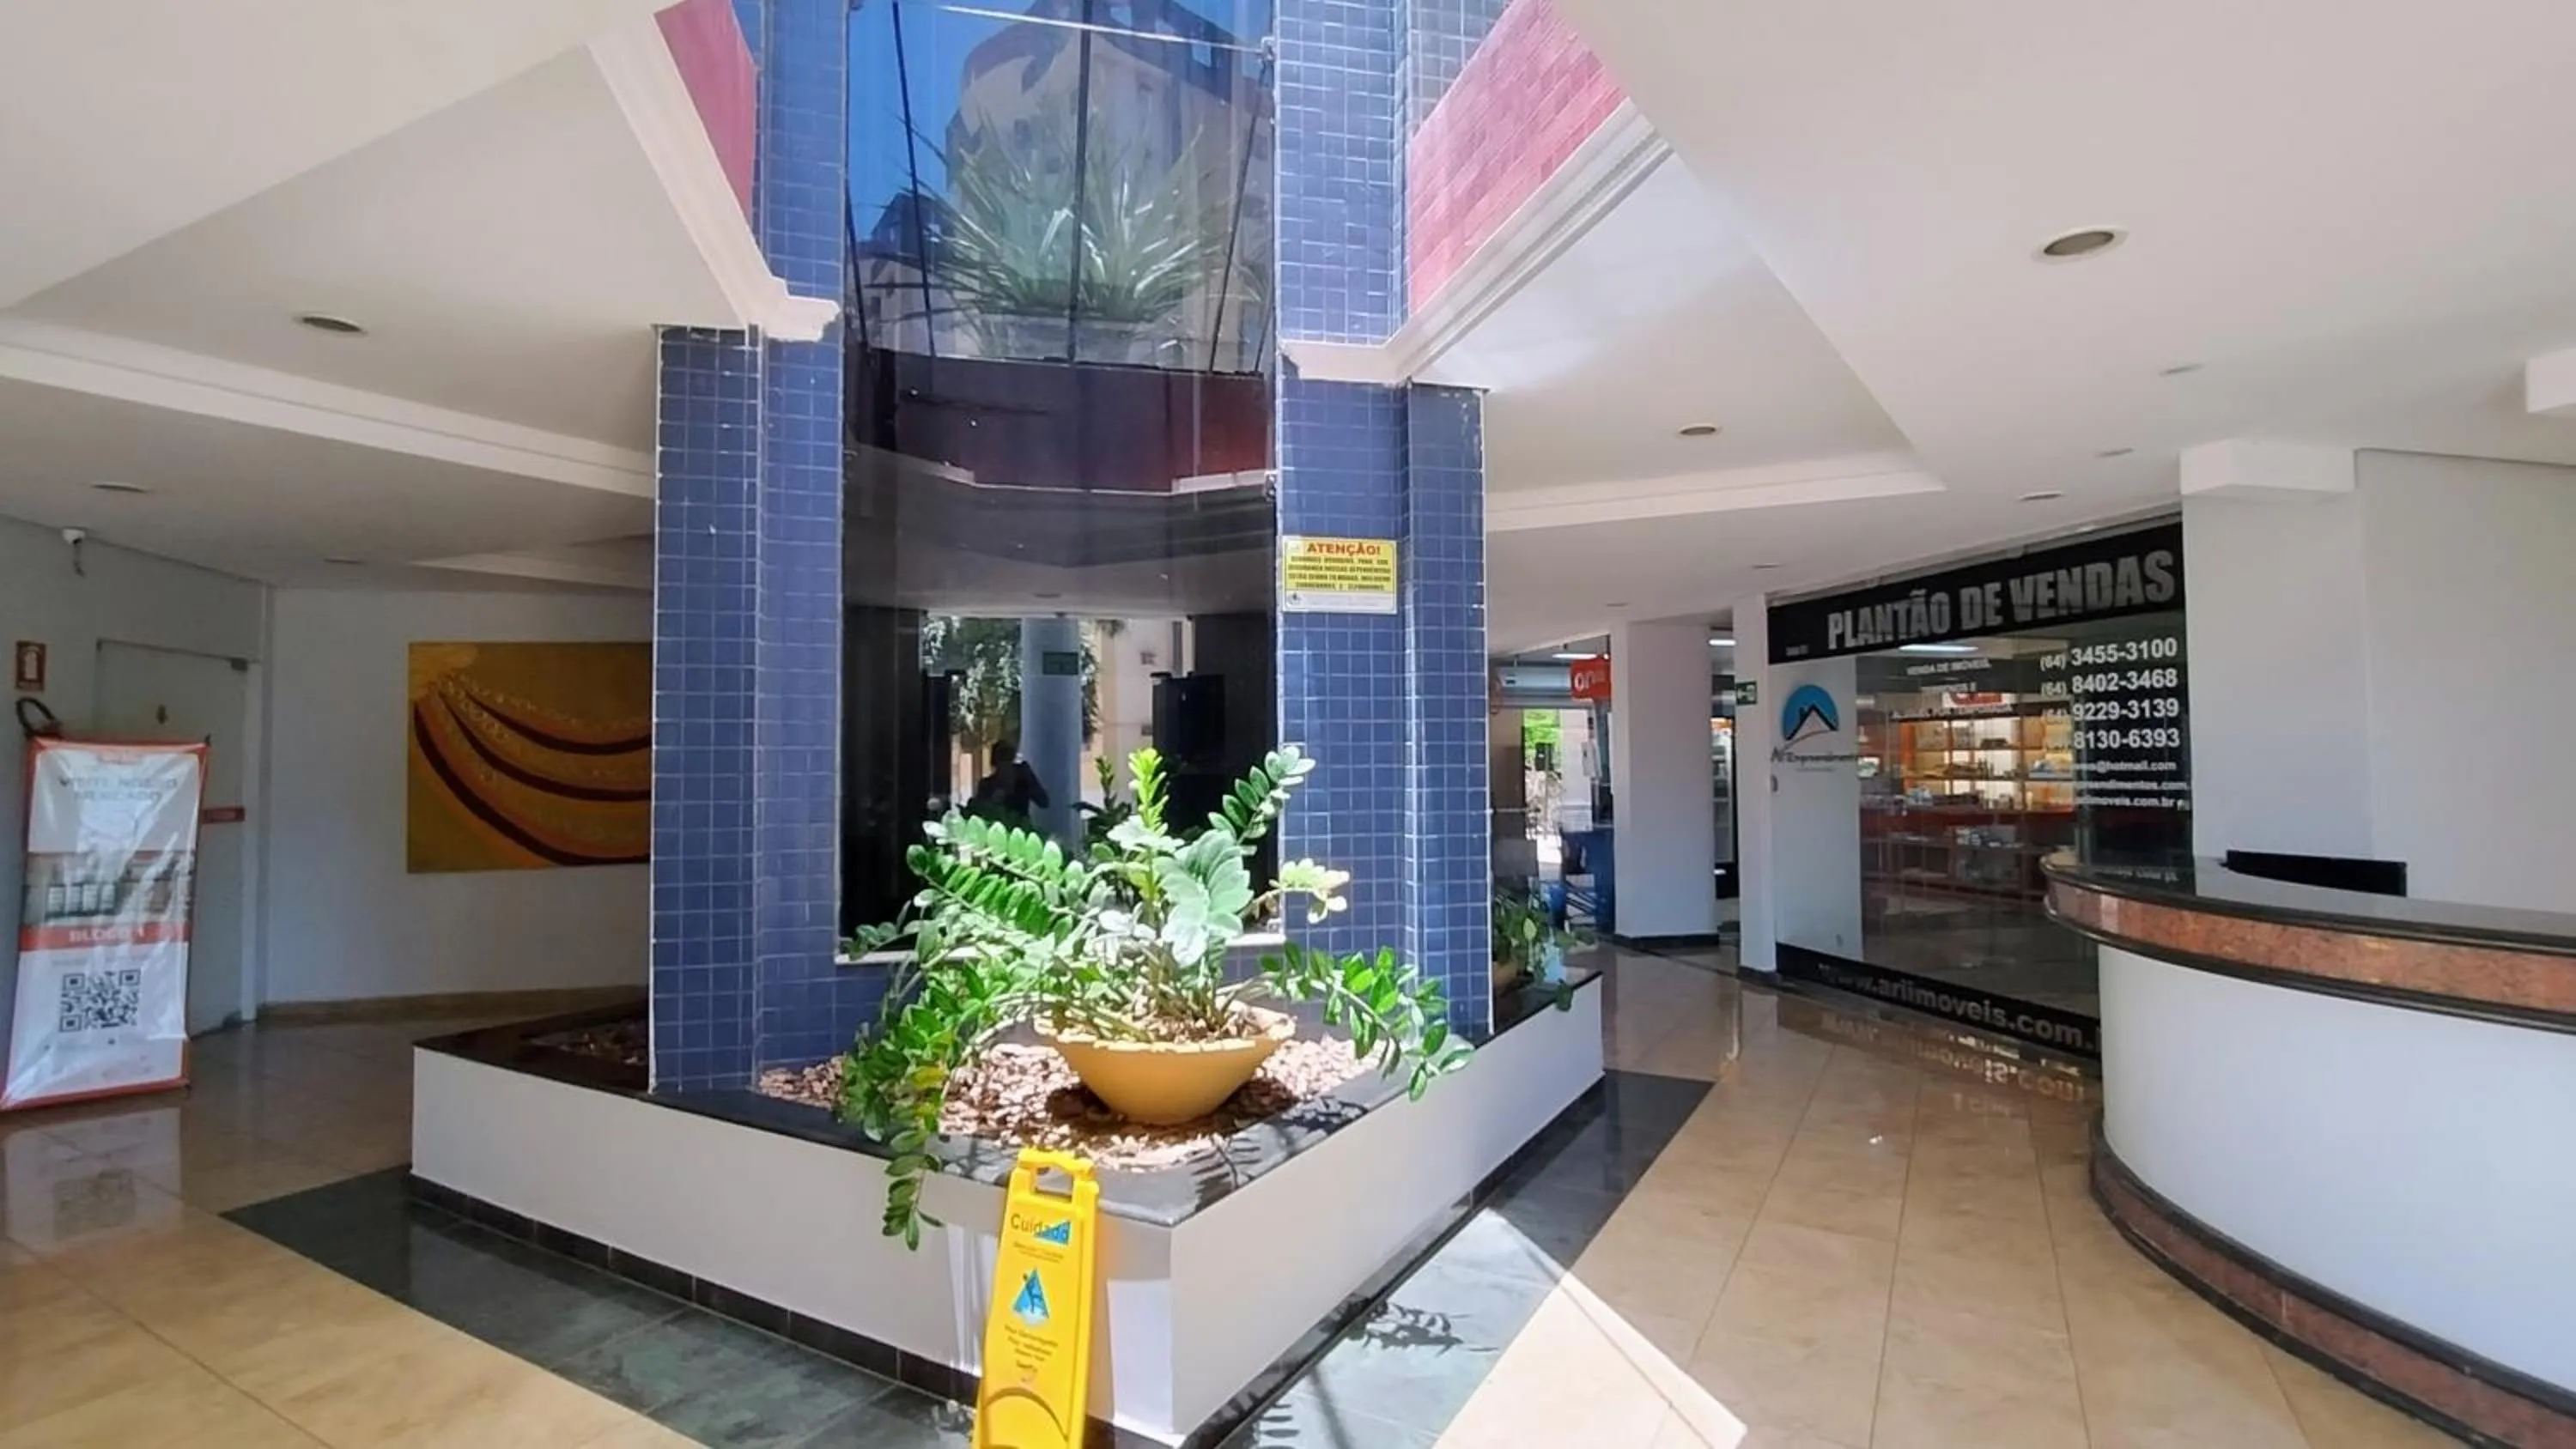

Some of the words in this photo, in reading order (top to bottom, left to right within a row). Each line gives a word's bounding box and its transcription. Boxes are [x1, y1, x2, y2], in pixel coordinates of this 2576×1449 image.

[1827, 588, 1951, 650] PLANTÃO
[1959, 581, 2003, 631] DE
[2008, 549, 2176, 622] VENDAS
[2039, 654, 2066, 671] (64)
[2071, 638, 2178, 666] 3455-3100
[2071, 668, 2178, 694] 8402-3468
[2072, 698, 2180, 722] 9229-3139
[2074, 727, 2181, 749] 8130-6393
